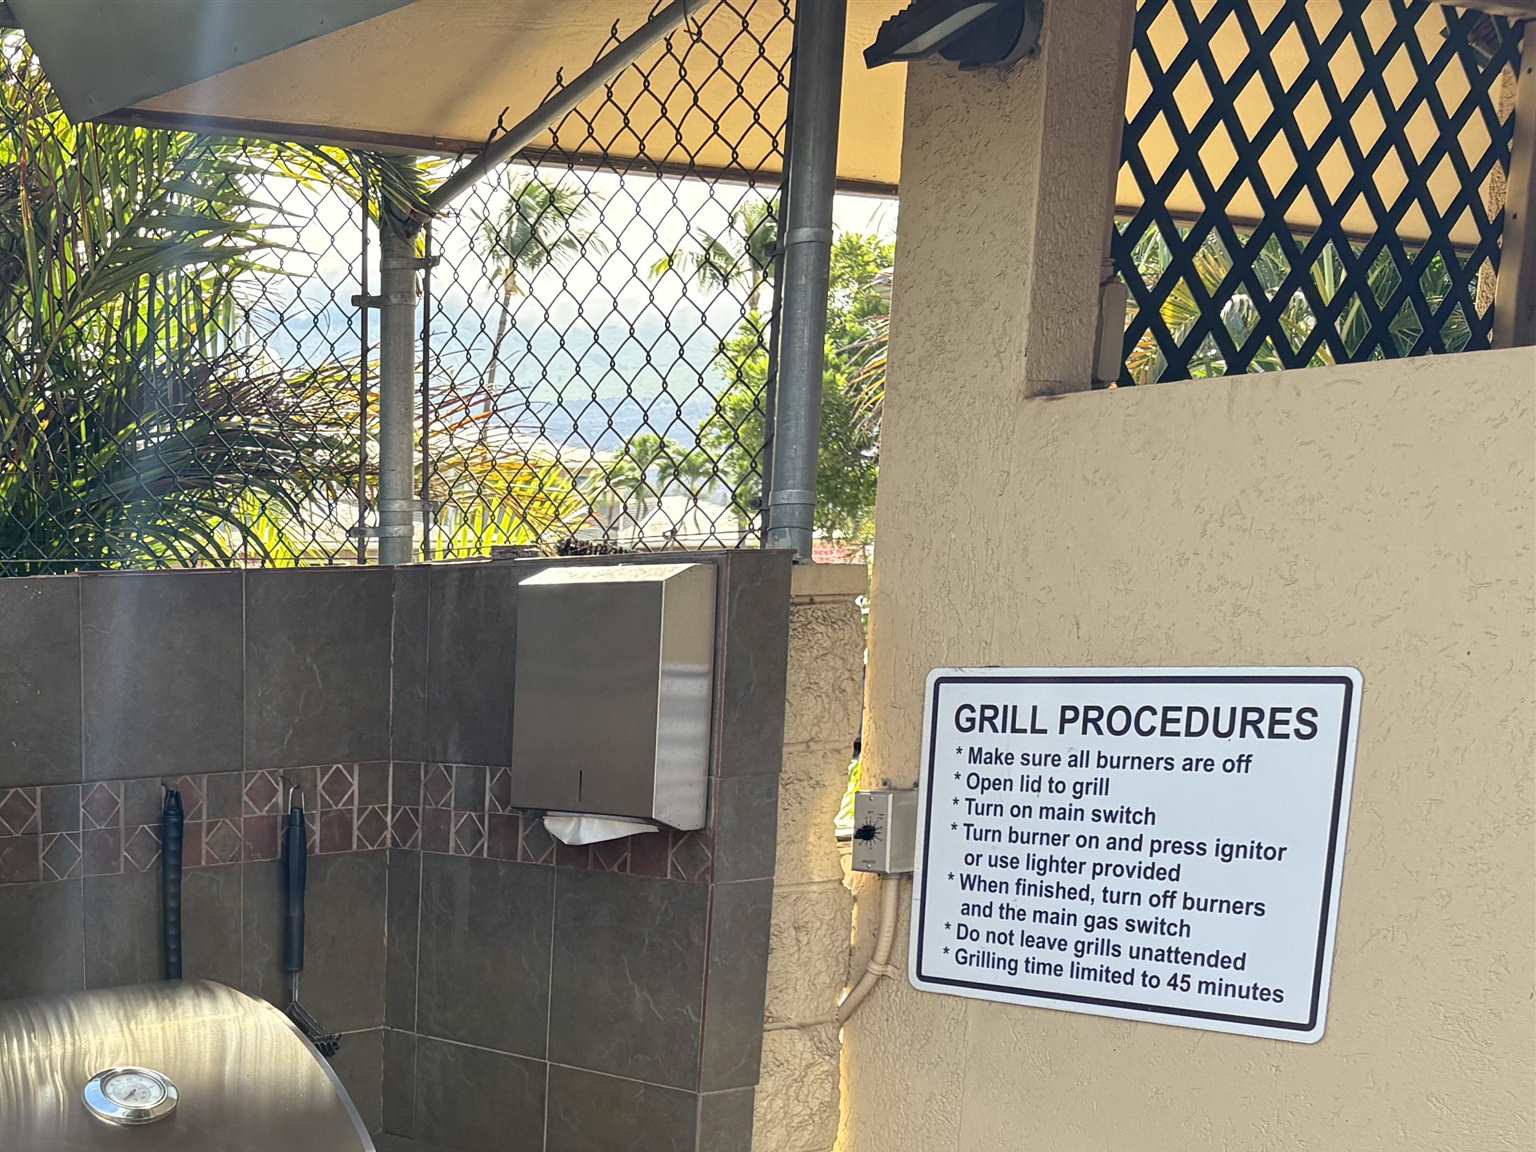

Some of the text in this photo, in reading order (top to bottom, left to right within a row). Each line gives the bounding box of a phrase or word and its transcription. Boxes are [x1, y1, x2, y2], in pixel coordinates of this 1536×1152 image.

[955, 704, 1318, 740] GRILL PROCEDURES
[968, 747, 1253, 773] Make sure all burners are off
[967, 772, 1109, 799] Open lid to grill
[965, 798, 1155, 825] Turn on main switch
[963, 823, 1287, 863] Turn burner on and press ignitor
[964, 853, 1181, 882] or use lighter provided
[960, 873, 1265, 916] When finished, turn off burners
[961, 901, 1190, 938] and the main gas switch
[957, 923, 1246, 971] Do not leave grills unattended
[955, 948, 1284, 1003] Grilling time limited to 45 minutes
